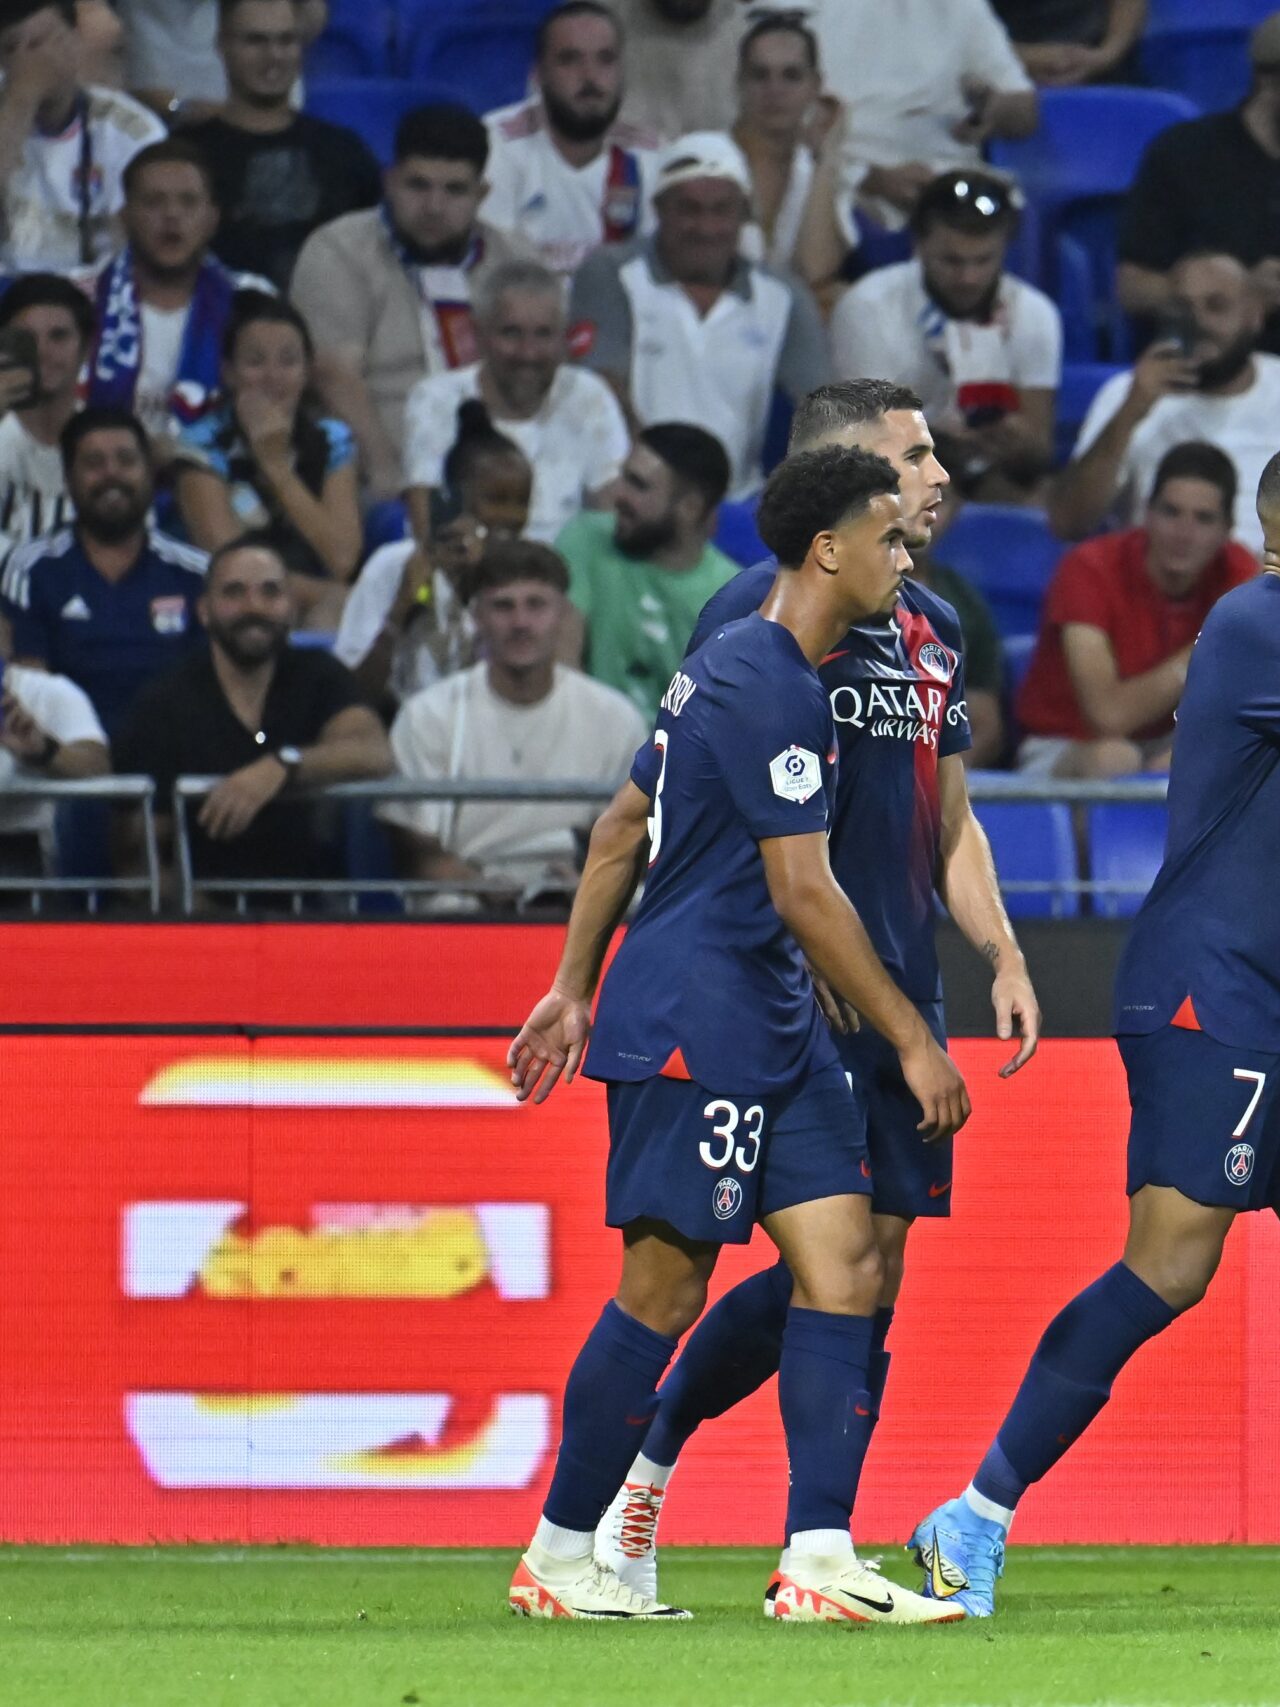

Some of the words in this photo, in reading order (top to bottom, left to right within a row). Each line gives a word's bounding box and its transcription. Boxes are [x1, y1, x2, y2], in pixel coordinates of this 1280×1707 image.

[829, 682, 942, 728] QATAR
[1231, 1068, 1266, 1139] 7
[699, 1099, 765, 1174] 33
[1231, 1145, 1254, 1157] PARIS
[717, 1179, 739, 1192] PARIS
